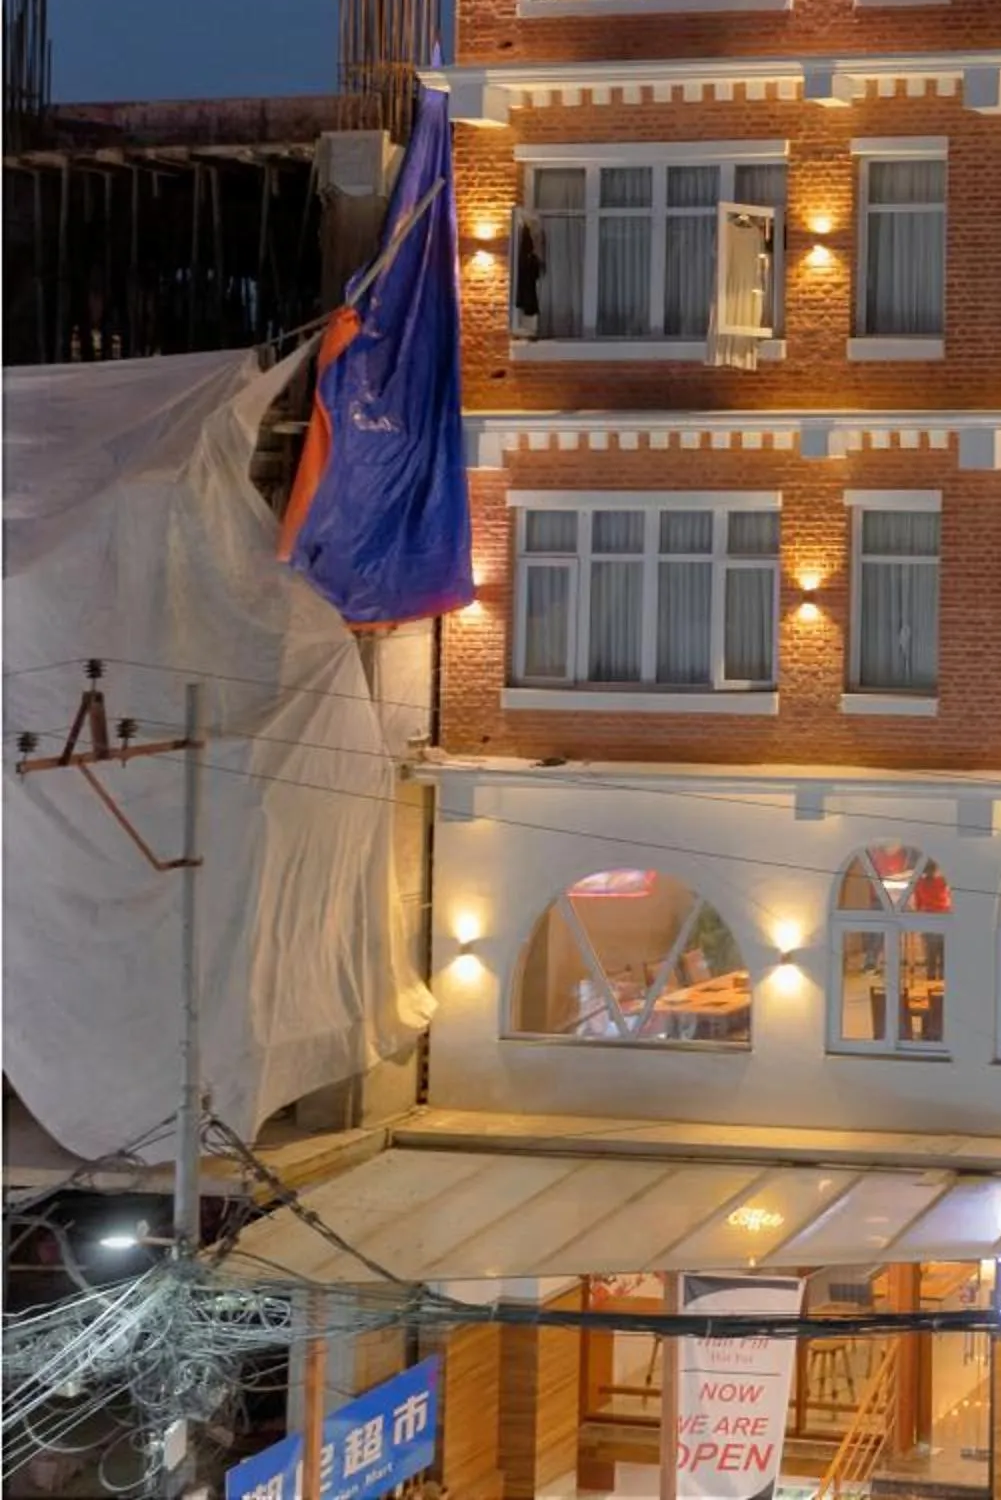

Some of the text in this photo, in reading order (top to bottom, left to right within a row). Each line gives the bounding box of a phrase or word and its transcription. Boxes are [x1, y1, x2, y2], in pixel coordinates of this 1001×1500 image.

[700, 1382, 764, 1403] NOW
[712, 1415, 769, 1437] ARE
[241, 1390, 430, 1500] 超市
